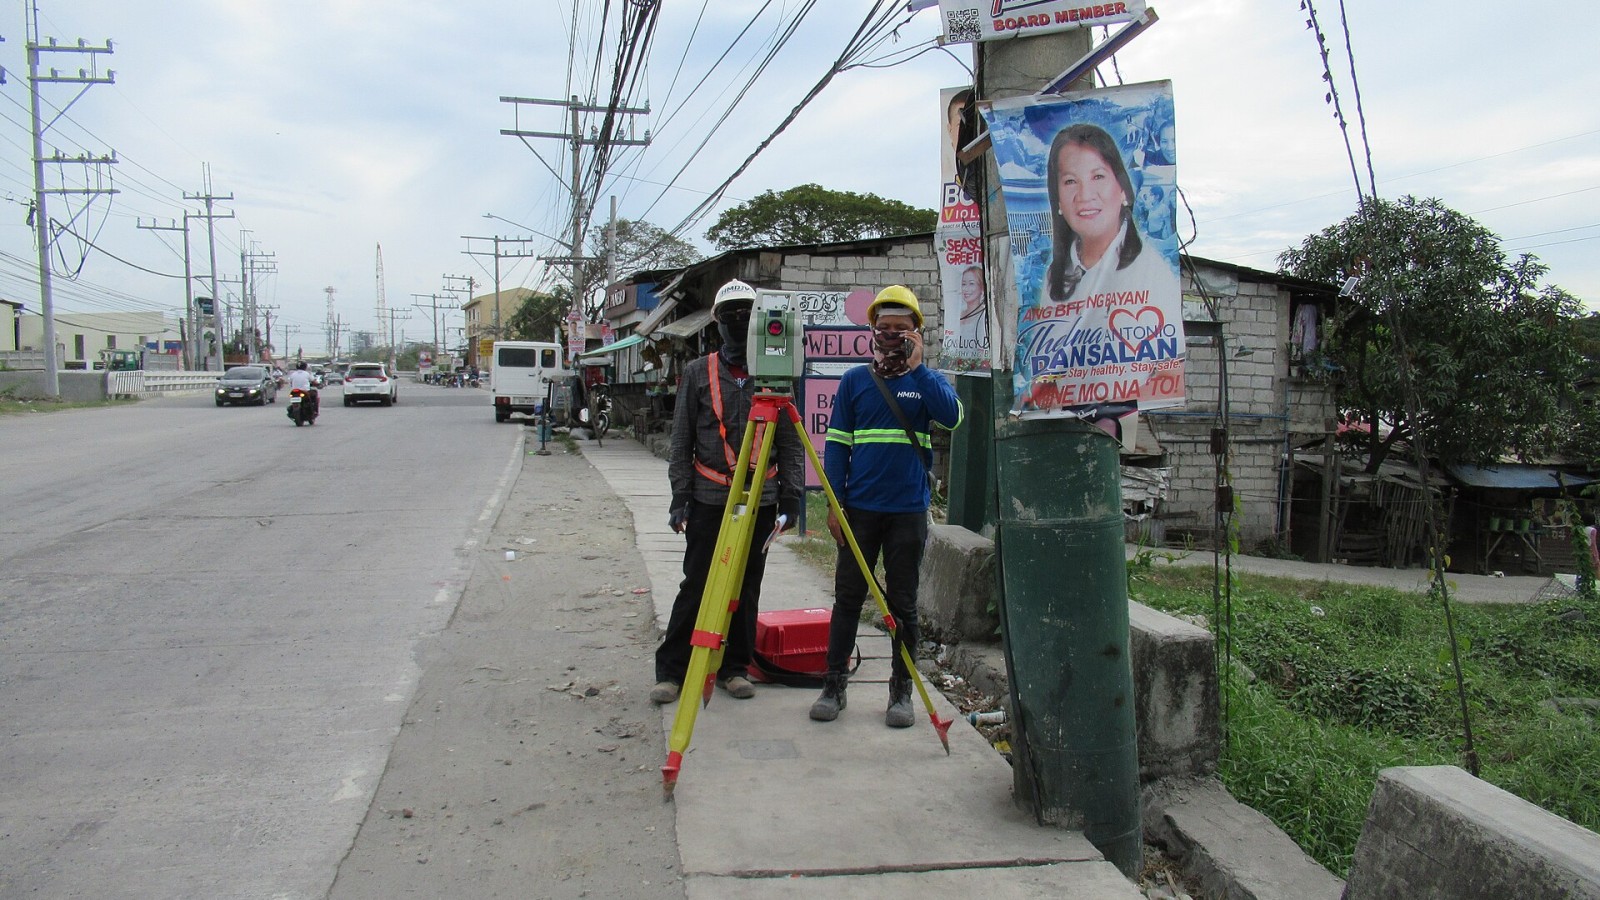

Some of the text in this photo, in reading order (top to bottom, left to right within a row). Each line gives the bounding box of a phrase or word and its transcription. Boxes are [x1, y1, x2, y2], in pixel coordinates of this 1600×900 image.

[993, 13, 1050, 31] BOARD
[1054, 2, 1127, 24] MEMBER
[943, 209, 980, 221] VIOL
[1022, 290, 1149, 322] ANG BFF NG BAYAN!
[1017, 317, 1176, 365] Thelma ANTONIO
[1030, 338, 1177, 376] DANSALAN
[1068, 360, 1181, 379] Stay healthy. Stay safe.
[1078, 381, 1109, 402] MO
[1112, 379, 1140, 398] NA
